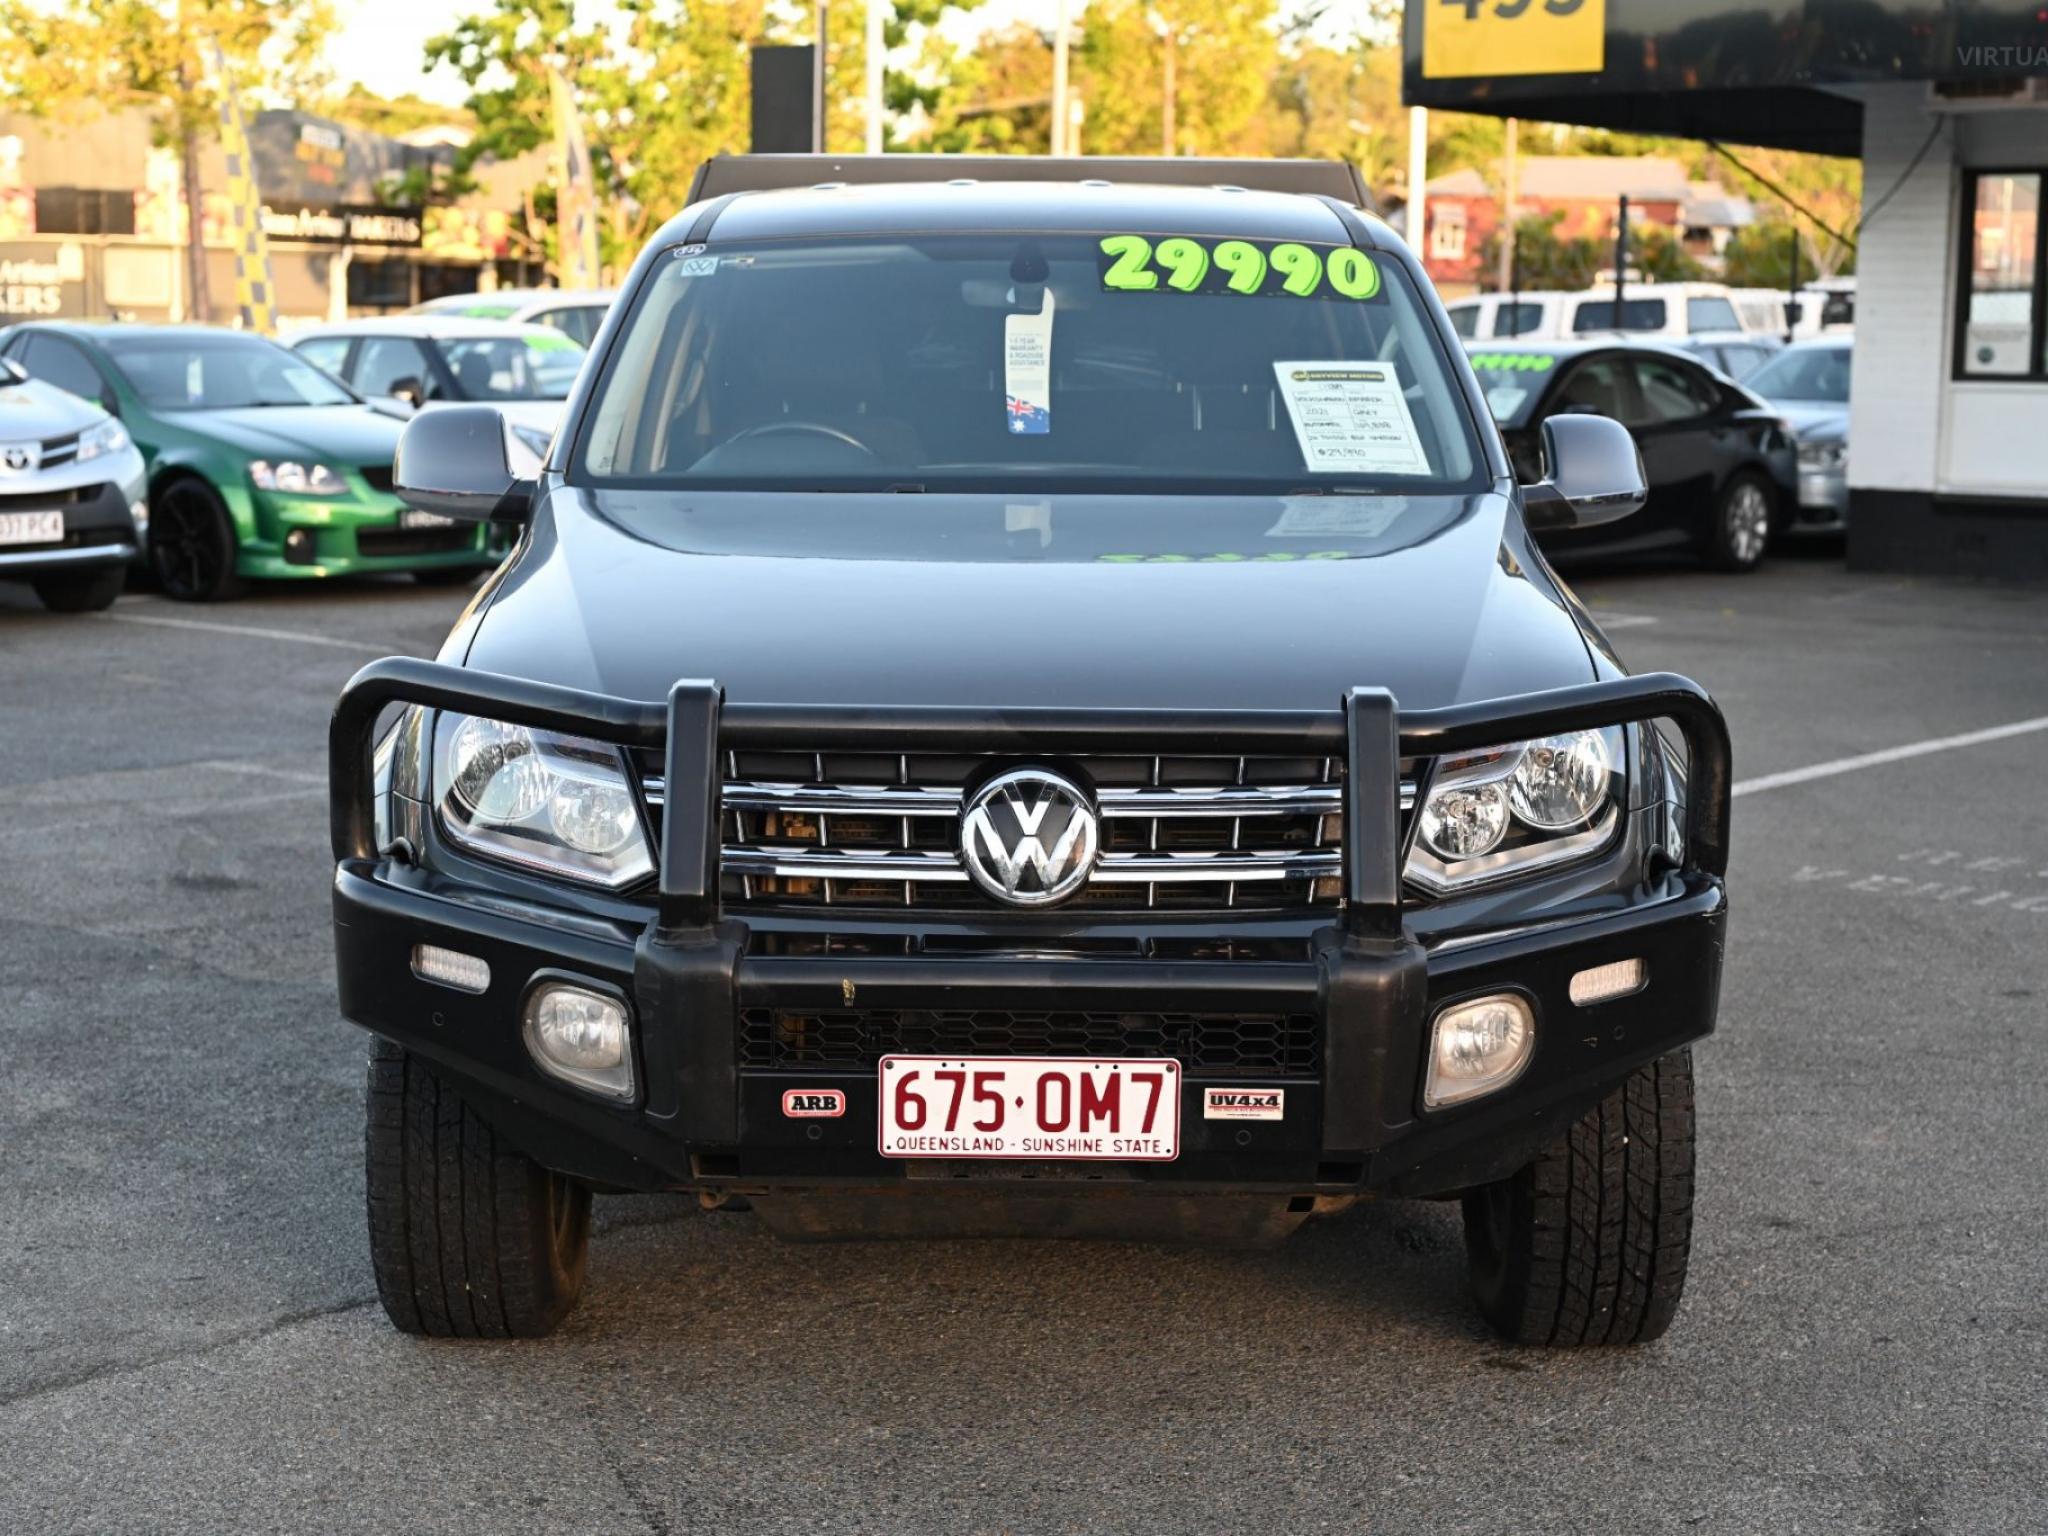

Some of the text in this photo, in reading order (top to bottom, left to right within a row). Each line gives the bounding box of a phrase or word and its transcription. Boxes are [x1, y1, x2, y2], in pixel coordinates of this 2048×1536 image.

[1099, 235, 1380, 299] 29990
[791, 1095, 838, 1110] ARB
[896, 1136, 1161, 1153] QUEENSLAND SUNSHINE STATE
